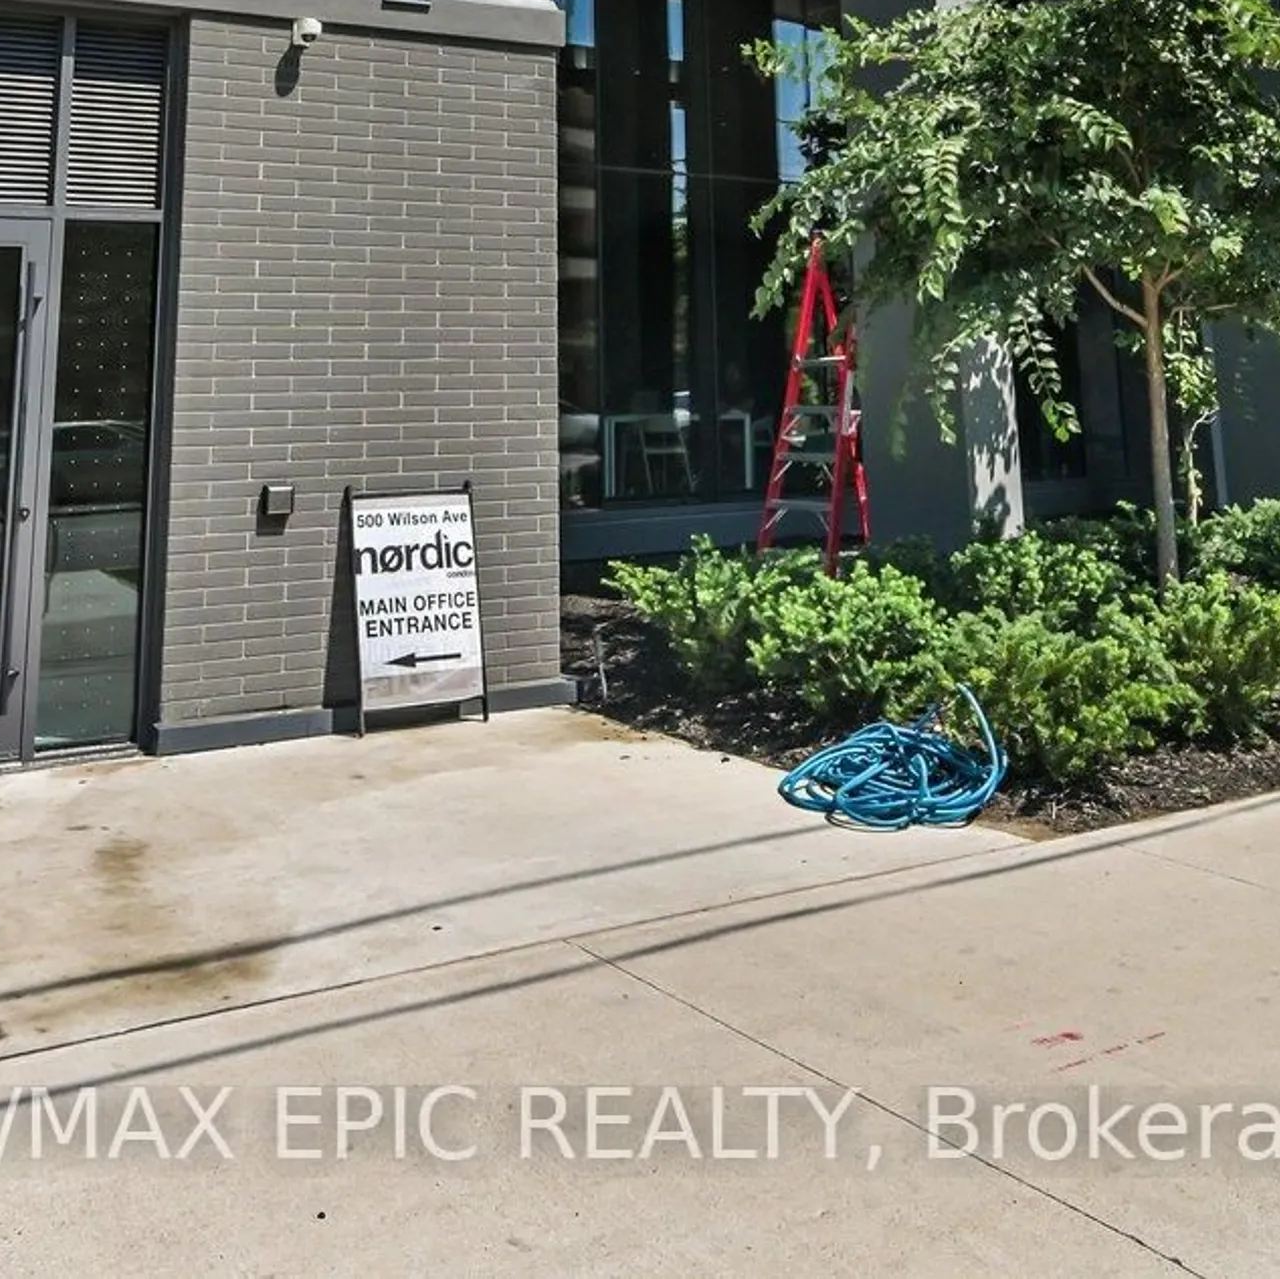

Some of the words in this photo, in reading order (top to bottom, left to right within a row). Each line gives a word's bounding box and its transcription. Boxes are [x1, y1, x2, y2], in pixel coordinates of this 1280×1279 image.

[356, 514, 383, 528] 500
[388, 512, 438, 527] Wilson
[442, 510, 468, 523] Ave
[359, 597, 407, 616] MAIN
[413, 591, 476, 612] OFFICE
[366, 612, 473, 638] ENTRANCE
